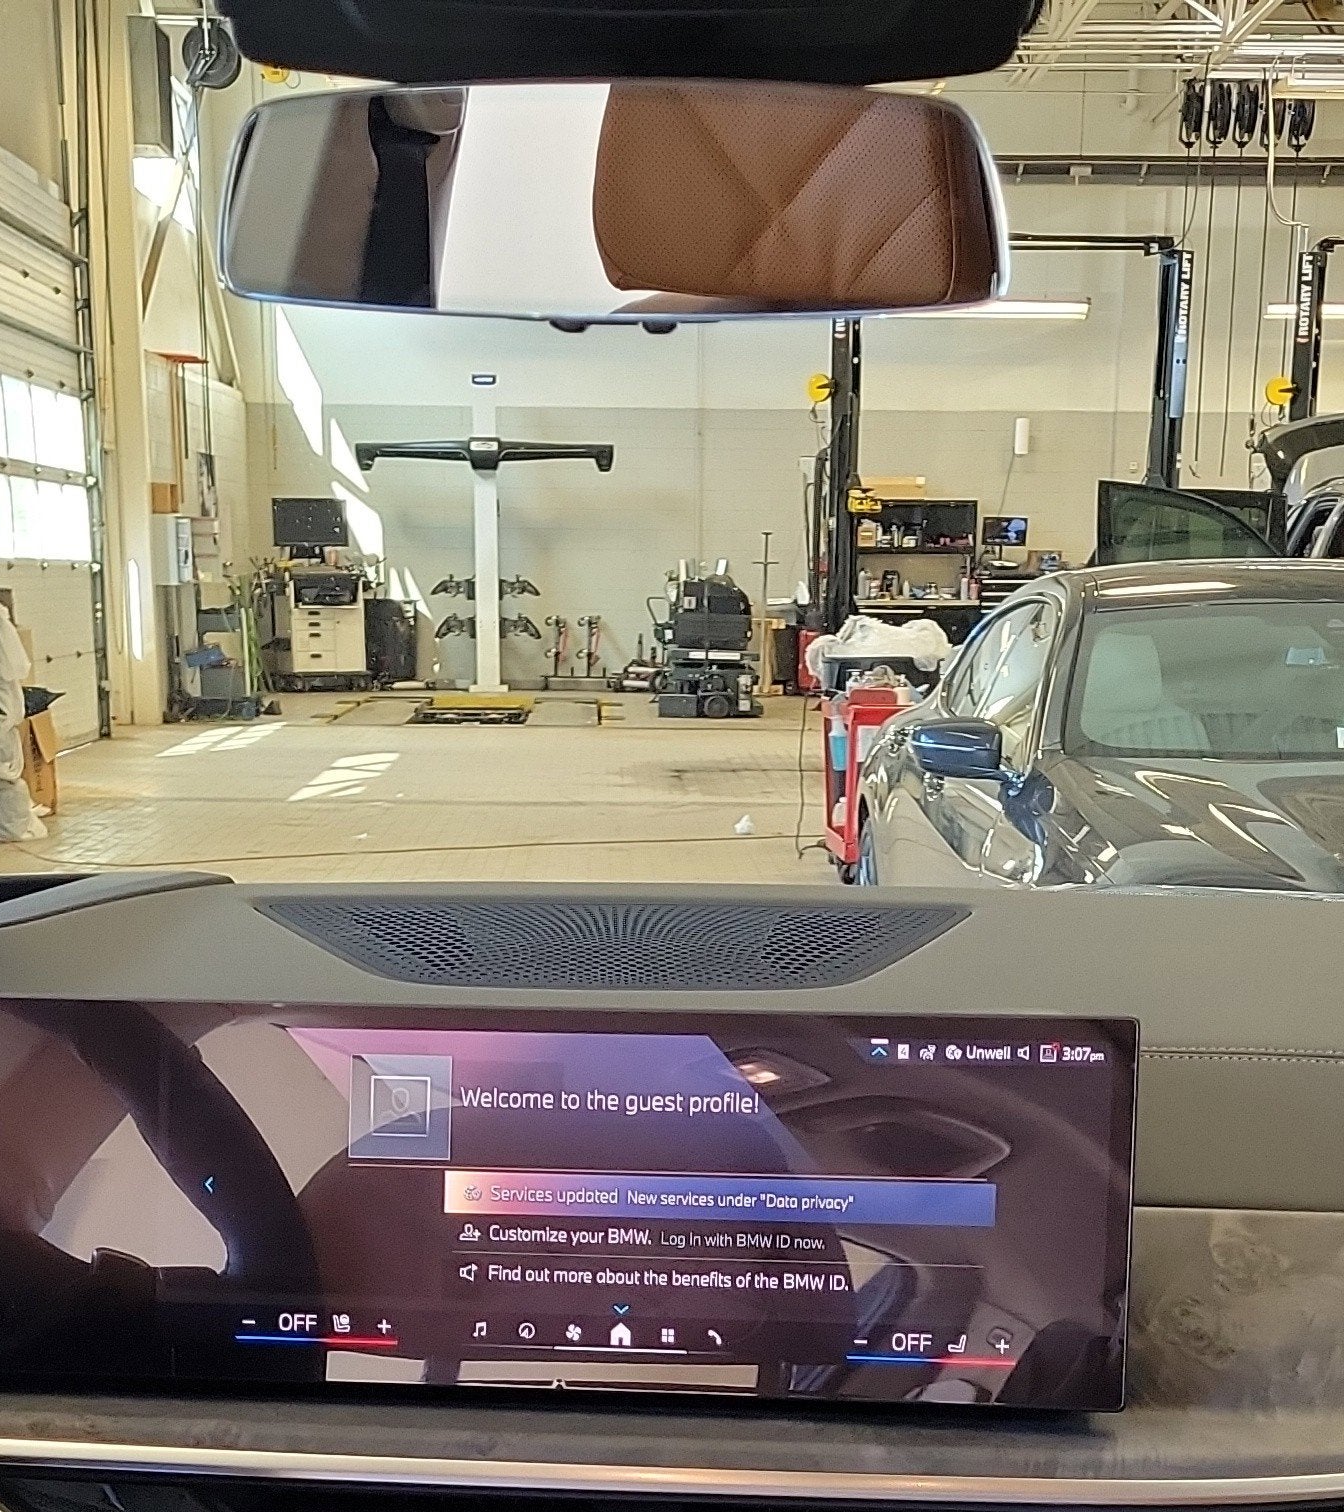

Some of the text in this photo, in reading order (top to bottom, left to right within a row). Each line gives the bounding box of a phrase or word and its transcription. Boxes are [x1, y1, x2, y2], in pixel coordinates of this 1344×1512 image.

[1177, 252, 1193, 335] ROTARY LIFT
[1298, 254, 1313, 336] ROTARY LIFT
[966, 1045, 1011, 1060] Unwell
[1062, 1046, 1105, 1062] 3:07pm
[460, 1087, 759, 1117] Welcome to the guest profile!
[490, 1185, 854, 1212] Services updated New services under "Data privacy"
[489, 1225, 825, 1250] Customize your BMW. Log in with BMW ID now.
[488, 1264, 849, 1292] Find out more about the benefits of the BMW ID.
[278, 1313, 318, 1332] OFF
[892, 1333, 932, 1352] OFF
